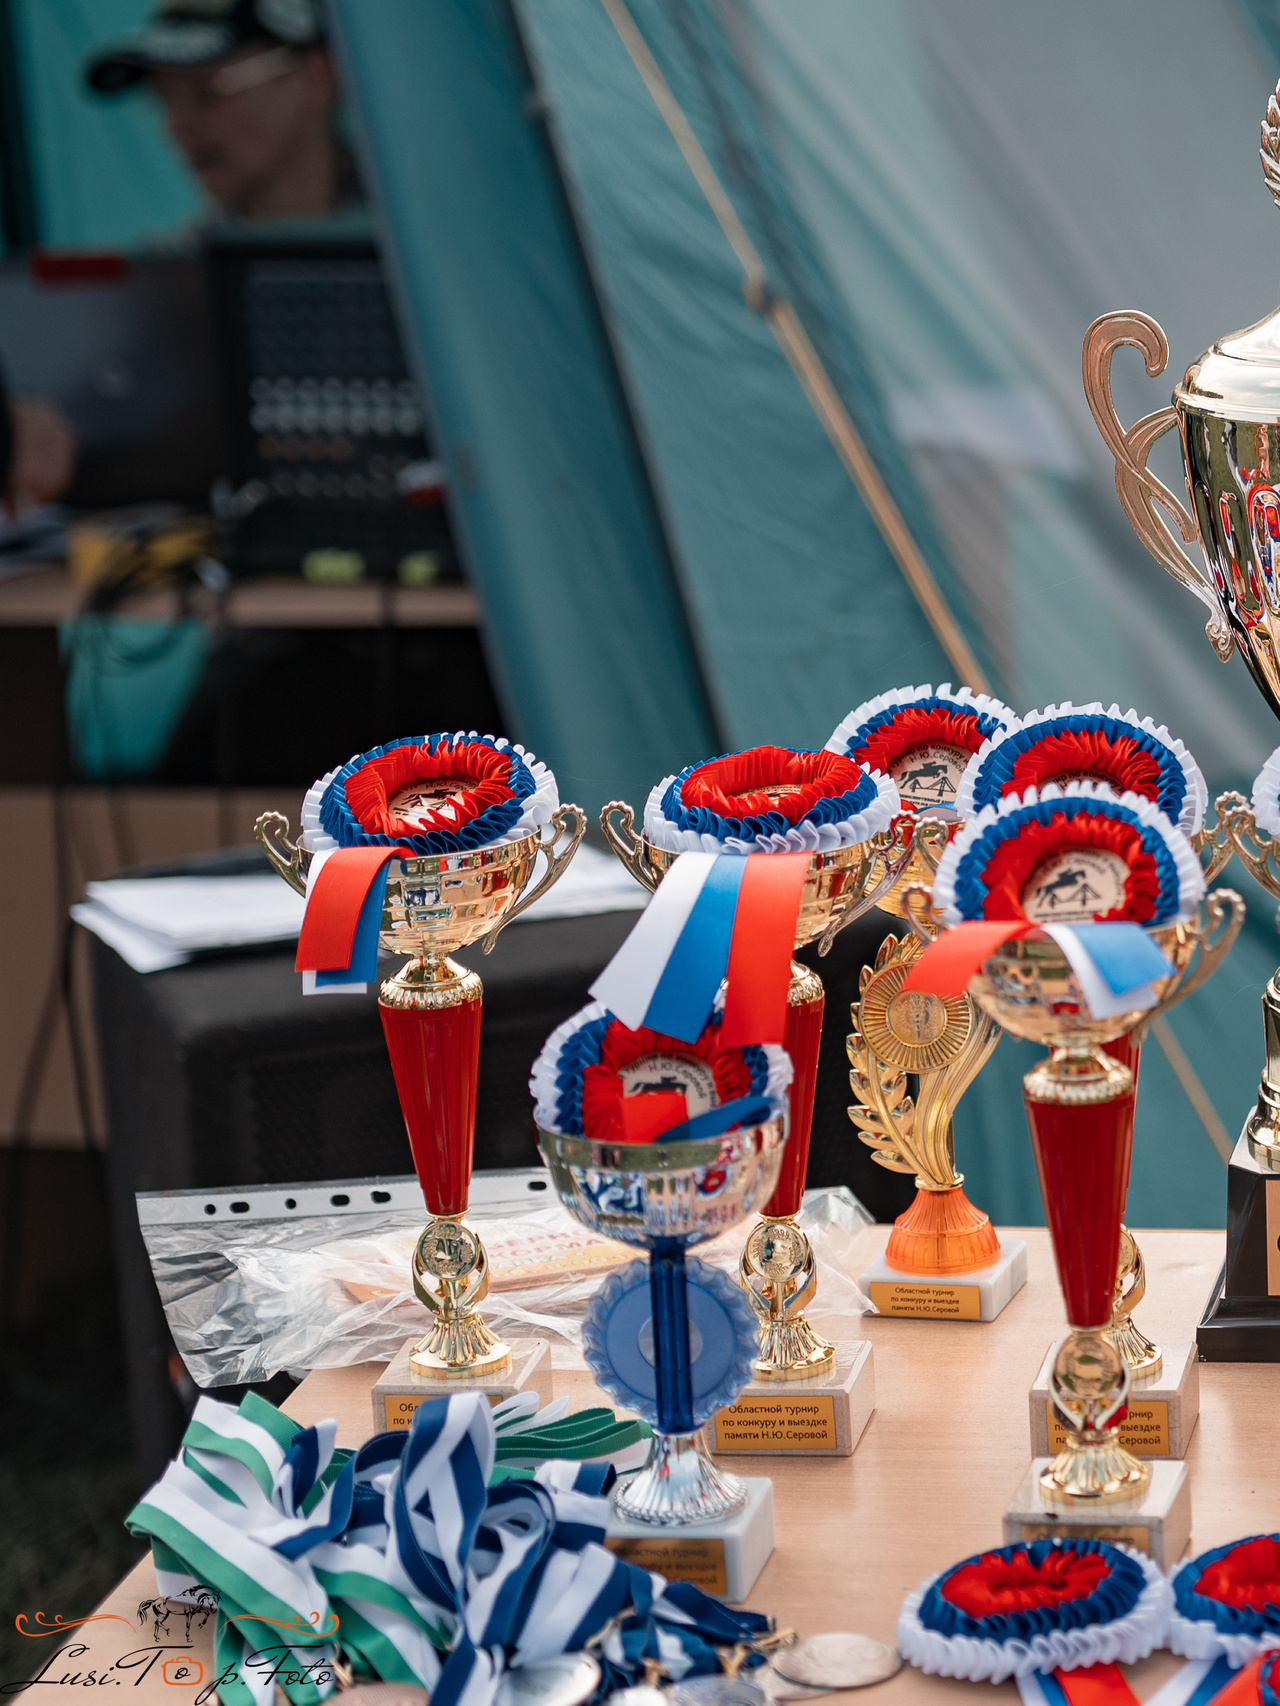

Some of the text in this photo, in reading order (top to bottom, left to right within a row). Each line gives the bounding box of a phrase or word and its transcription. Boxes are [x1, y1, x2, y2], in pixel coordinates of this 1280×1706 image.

[931, 744, 965, 759] конкуру
[895, 1287, 930, 1295] Областной
[916, 1306, 959, 1314] Н.Ю.Серовой
[729, 1405, 819, 1415] Областной турнир
[1129, 1411, 1153, 1420] рнир
[737, 1419, 776, 1428] конкуру
[788, 1419, 827, 1427] выездке
[1121, 1424, 1161, 1432] выездке
[762, 1430, 828, 1441] Н.Ю.Серовой
